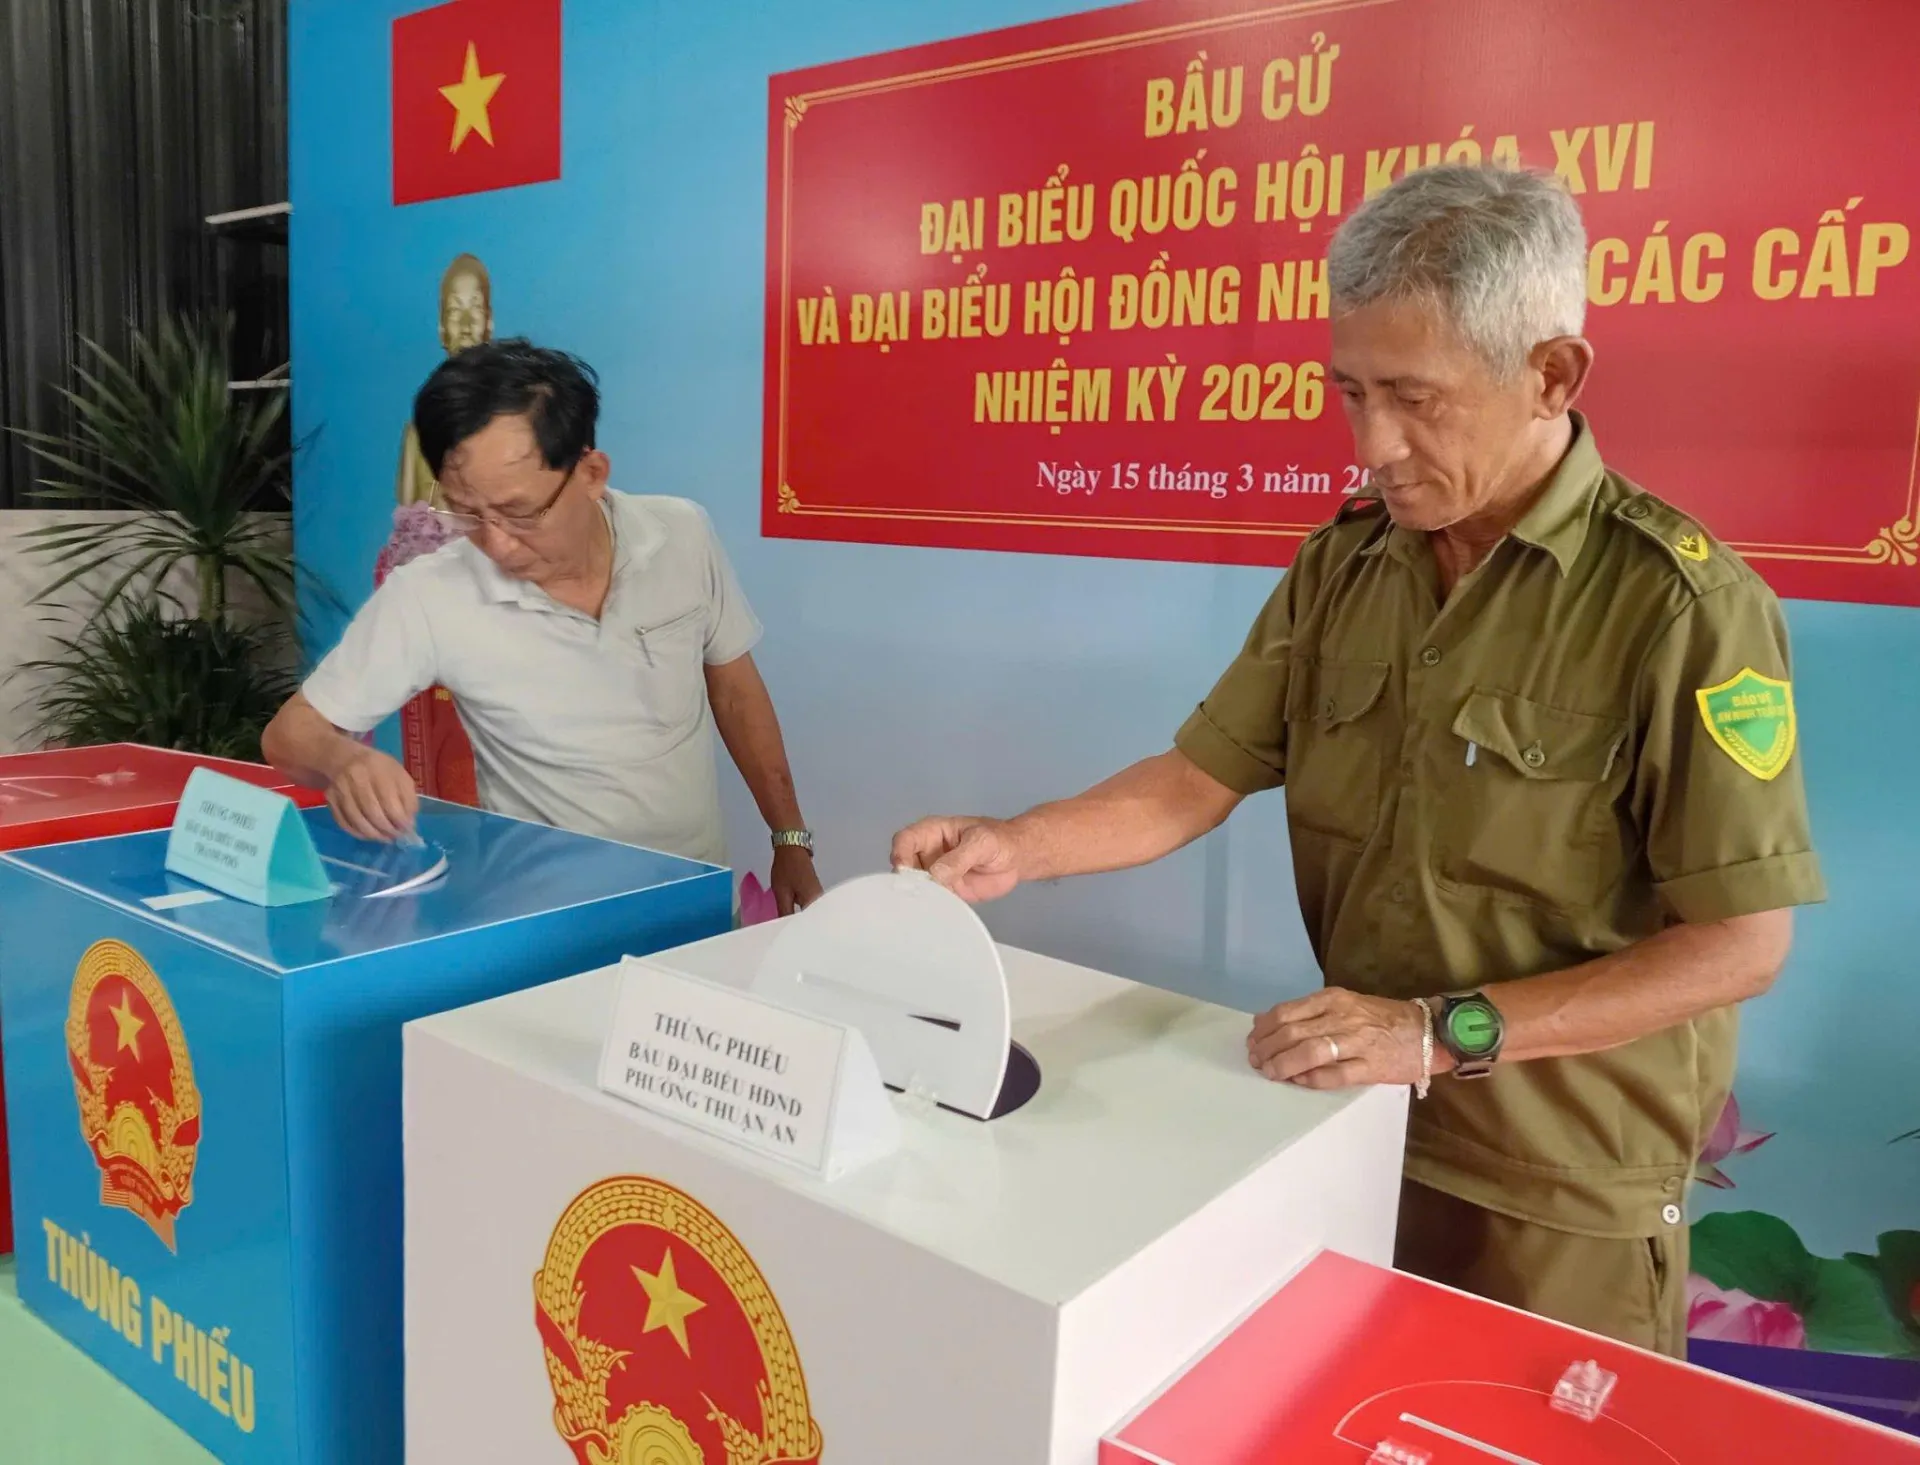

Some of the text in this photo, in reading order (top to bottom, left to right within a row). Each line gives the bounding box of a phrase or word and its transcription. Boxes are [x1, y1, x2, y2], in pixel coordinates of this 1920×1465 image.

[1146, 32, 1340, 137] BẦU CỬ
[920, 199, 983, 263] ĐẠI
[998, 164, 1094, 248] BIỂU
[1109, 150, 1237, 243] QUỐC
[1255, 145, 1344, 232] HỘI
[1550, 121, 1655, 194] XVI
[798, 287, 840, 345] VÀ
[850, 292, 909, 353] ĐẠI
[922, 263, 1010, 339] BIỂU
[1024, 266, 1094, 345] HỘI
[1109, 252, 1241, 329] ĐỒNG
[1587, 221, 1726, 306] CÁC
[1752, 197, 1909, 300] CẤP
[974, 354, 1325, 434] NHIỆM KỲ 2026
[1036, 461, 1101, 495] Ngày
[1111, 462, 1140, 490] 15
[1148, 463, 1228, 498] tháng
[1236, 463, 1254, 492] 3
[1263, 465, 1330, 493] năm
[749, 1083, 802, 1117] HĐND
[770, 1122, 797, 1145] AN
[42, 1217, 255, 1433] THÙNG PHIẾU
